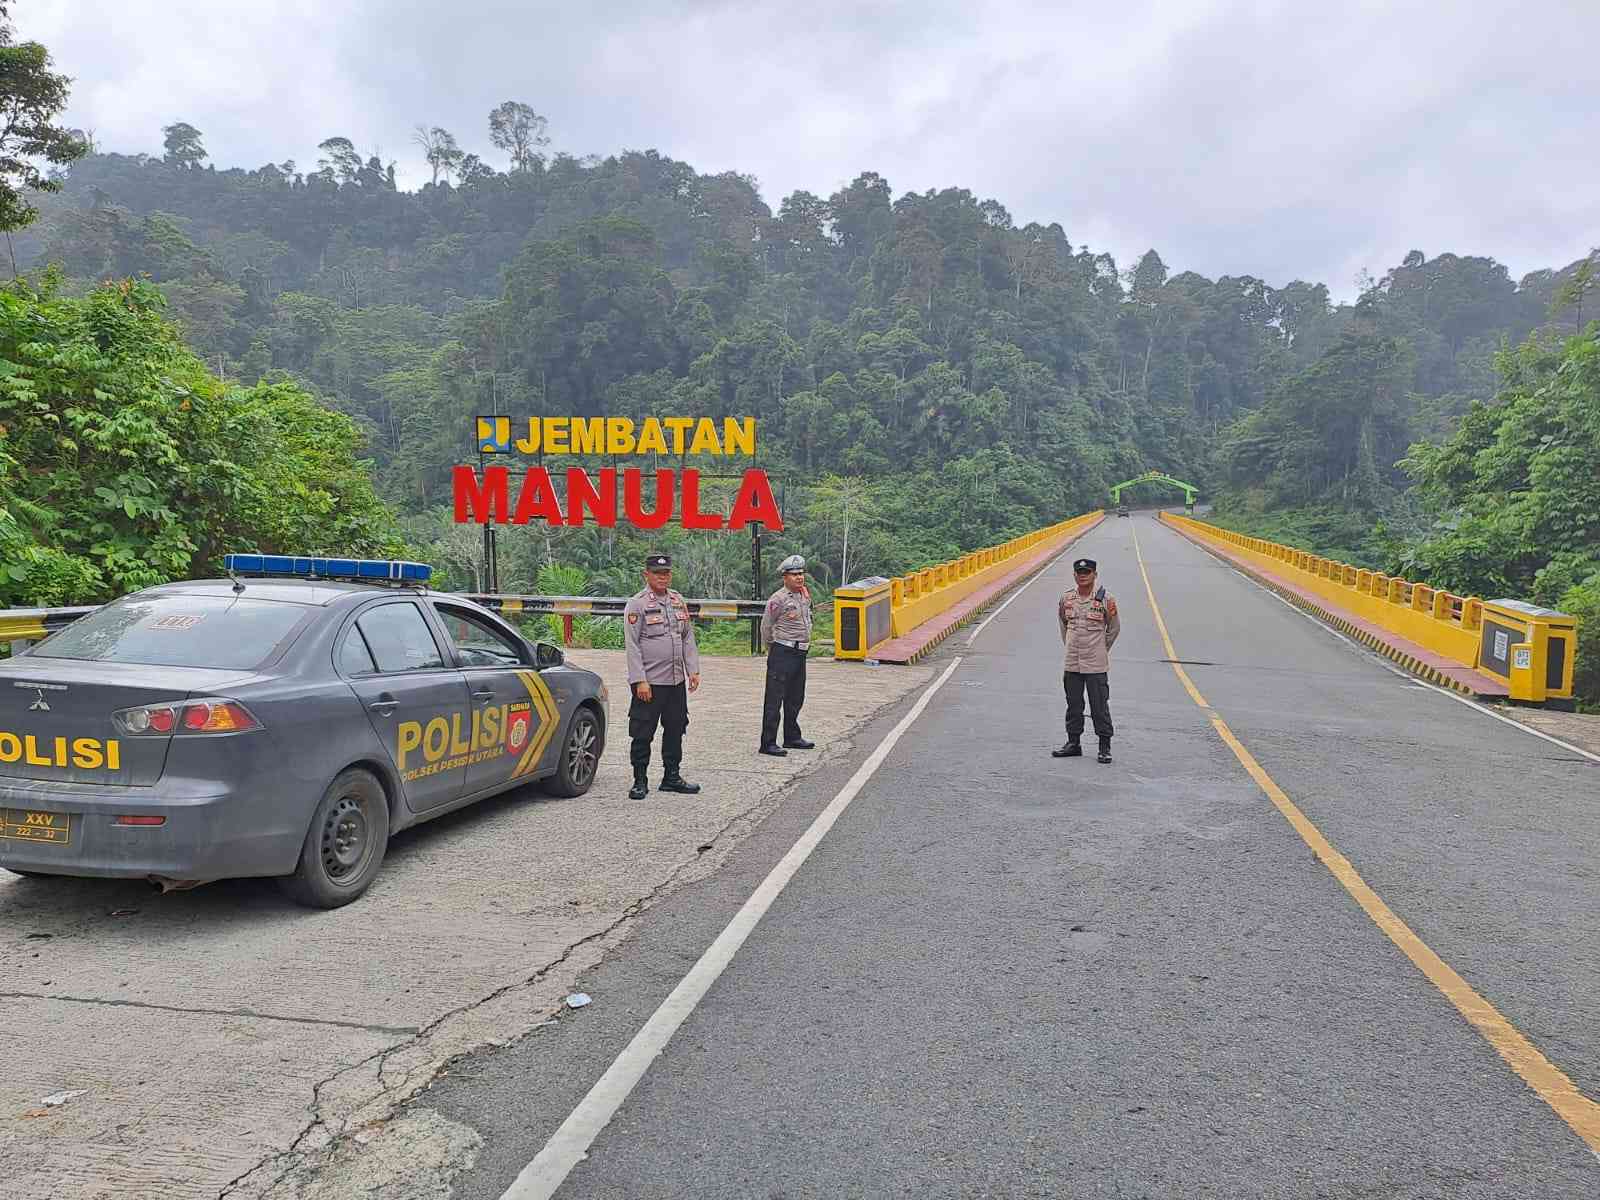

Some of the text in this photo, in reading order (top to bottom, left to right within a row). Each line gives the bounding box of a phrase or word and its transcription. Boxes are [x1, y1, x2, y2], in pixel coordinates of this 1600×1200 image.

[515, 416, 756, 455] JEMBATAN
[451, 466, 785, 532] MANULA
[397, 703, 509, 769] POLISI
[25, 812, 55, 826] XXV
